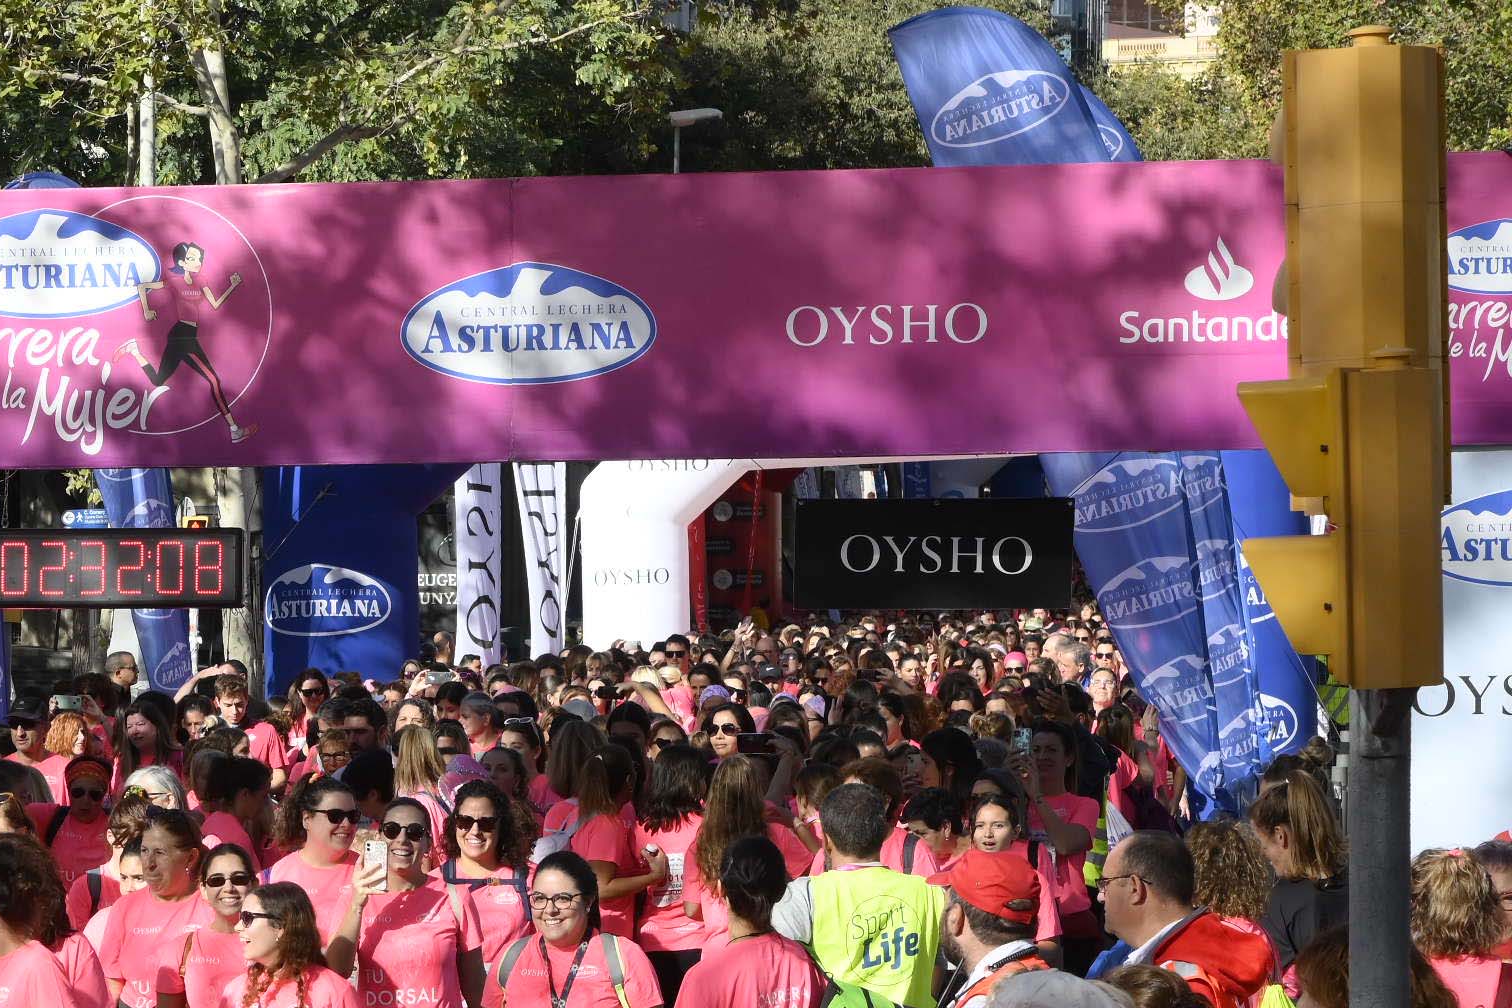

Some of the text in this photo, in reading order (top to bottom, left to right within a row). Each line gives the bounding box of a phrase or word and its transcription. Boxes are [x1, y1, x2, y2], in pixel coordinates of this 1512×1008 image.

[460, 303, 628, 318] CENTRAL LECHERA
[786, 302, 988, 347] OYSHO
[1119, 309, 1288, 343] Santande
[421, 310, 637, 353] ASTURIANA
[2, 370, 26, 410] la
[21, 362, 171, 456] Mujer
[0, 541, 223, 595] 02:32:08
[840, 534, 1033, 575] OYSHO
[594, 567, 670, 586] OYSHO
[269, 596, 382, 622] ASTURIANA
[852, 903, 908, 940] Sport
[861, 927, 919, 970] Life
[366, 969, 384, 984] TU
[366, 987, 439, 1006] DORSAL
